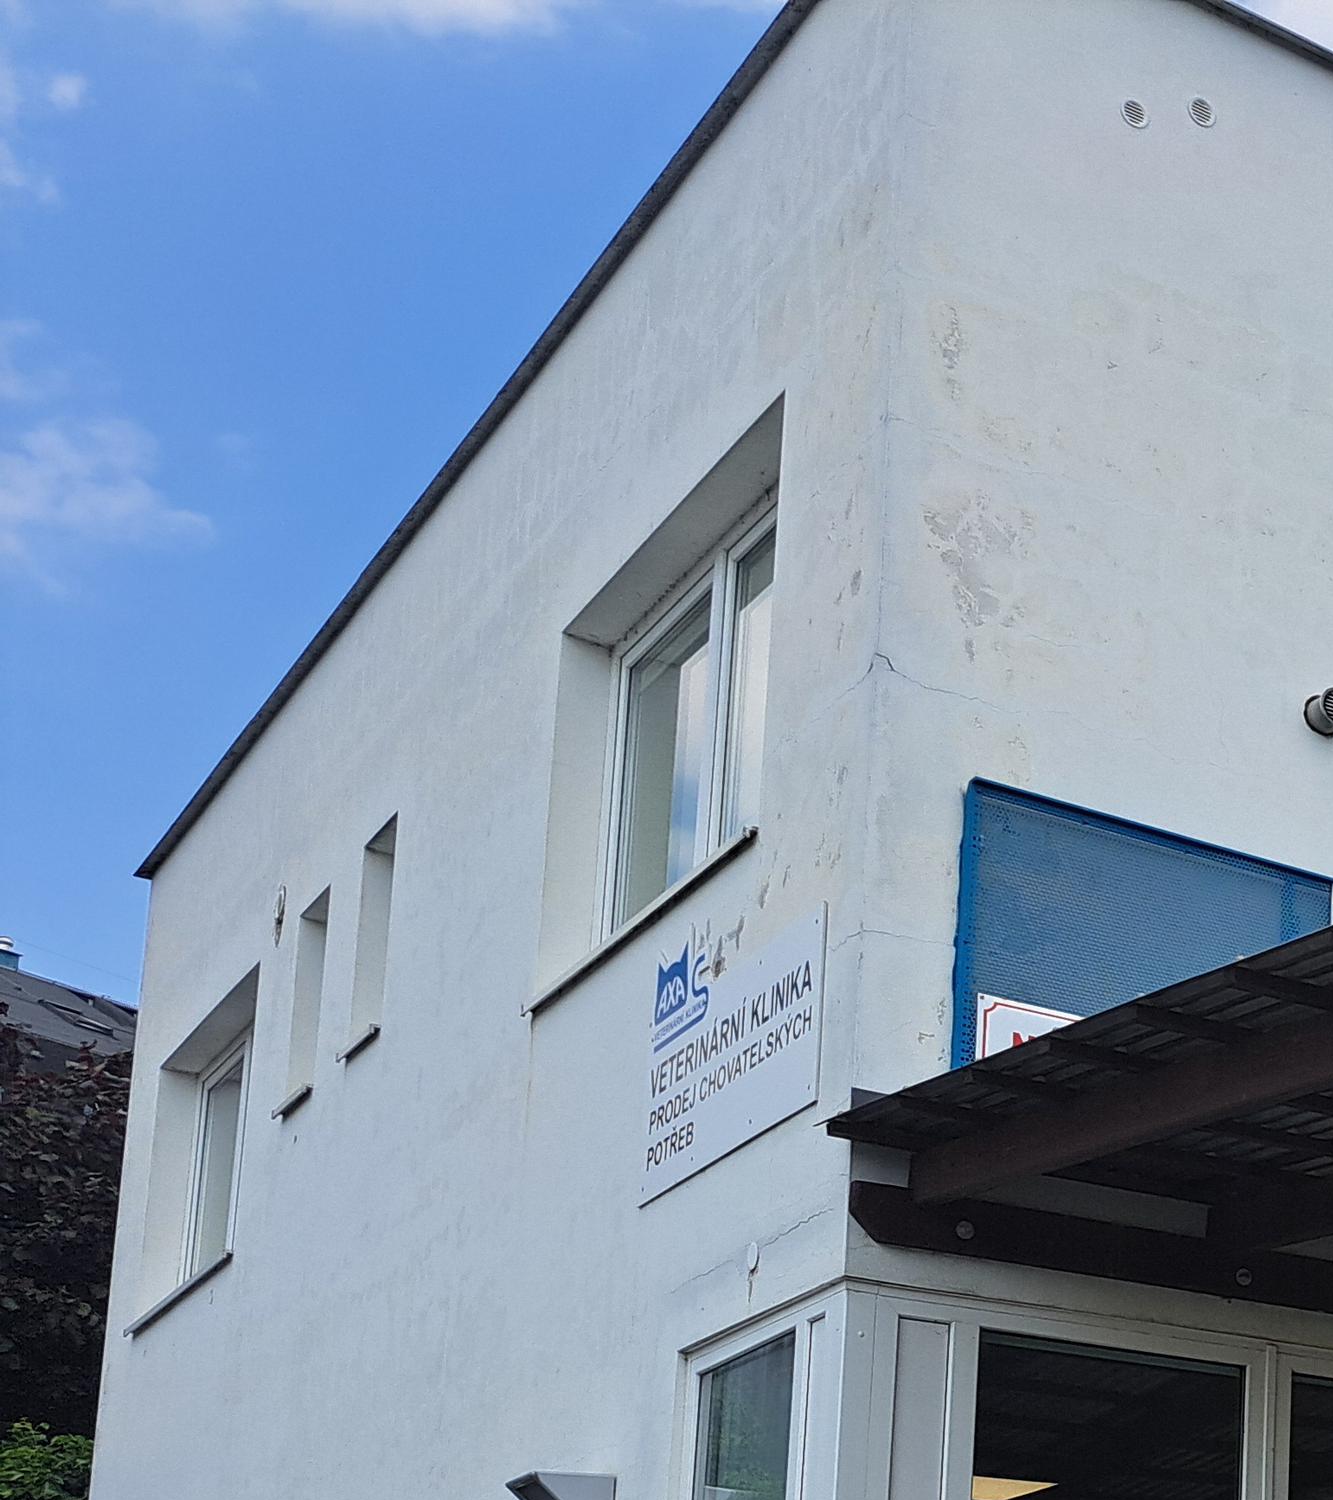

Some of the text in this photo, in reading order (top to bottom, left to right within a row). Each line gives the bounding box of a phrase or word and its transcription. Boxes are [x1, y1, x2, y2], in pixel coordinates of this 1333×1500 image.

[651, 960, 812, 1099] VETERINÁRNÍ KLINIKA
[657, 976, 685, 1019] AXA
[649, 1005, 812, 1135] PRODEJ CHOVATELSKÝCH
[646, 1122, 694, 1171] POTŘEB
